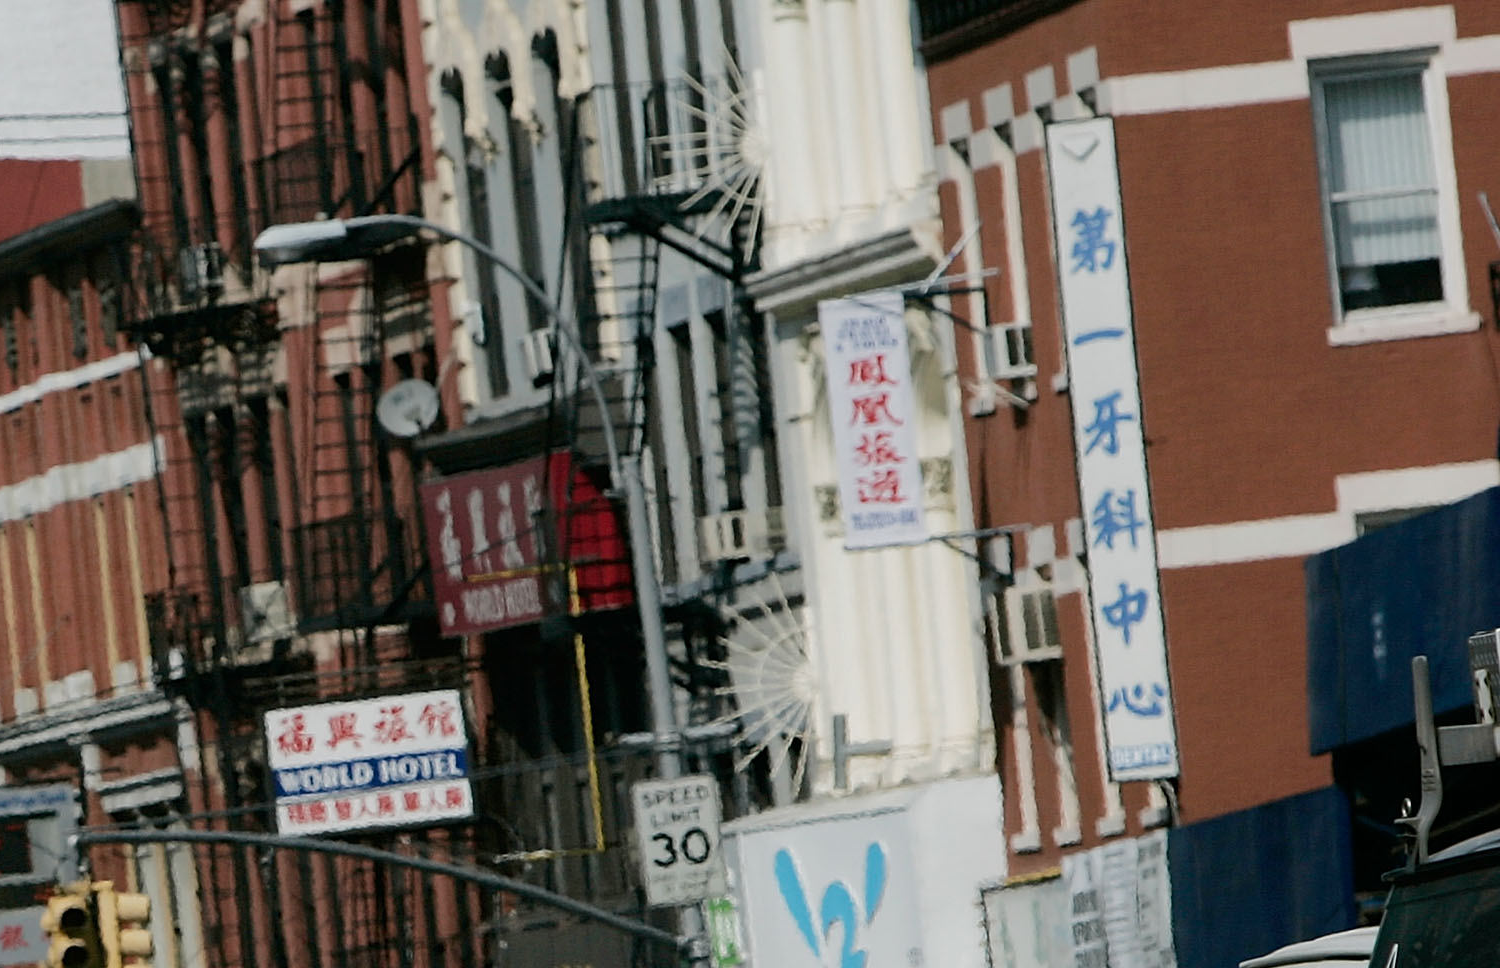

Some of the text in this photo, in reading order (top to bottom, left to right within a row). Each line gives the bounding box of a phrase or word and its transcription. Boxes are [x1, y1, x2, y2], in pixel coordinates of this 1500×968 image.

[1071, 205, 1165, 718] 第一牙科中心
[277, 752, 465, 795] WORLD HOTEL
[643, 785, 710, 809] SPEED
[651, 806, 700, 829] LIMIT
[652, 827, 710, 868] 30
